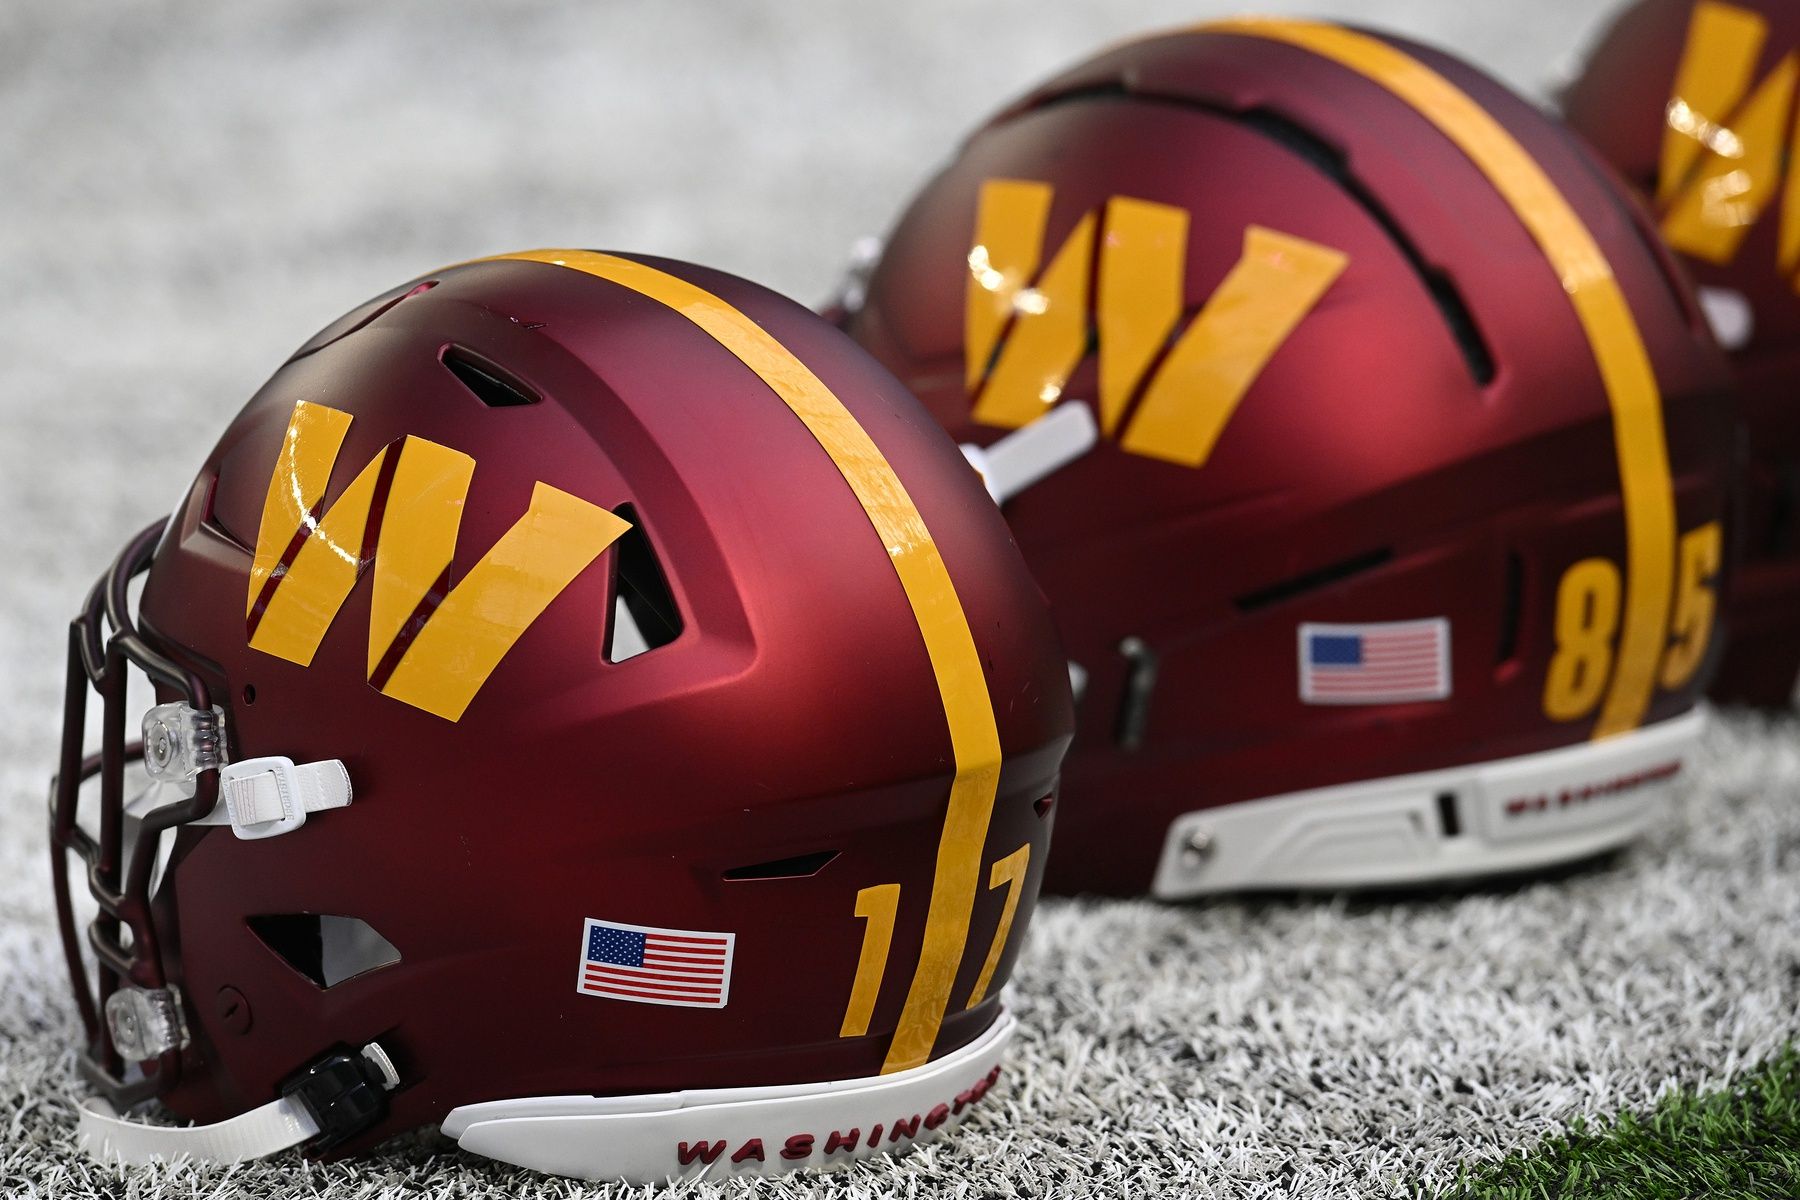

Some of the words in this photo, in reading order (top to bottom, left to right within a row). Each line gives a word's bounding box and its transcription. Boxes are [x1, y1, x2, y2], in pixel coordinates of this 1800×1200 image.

[965, 179, 1350, 468] W
[246, 400, 633, 723] W
[1541, 520, 1723, 722] 85
[839, 843, 1031, 1038] 17
